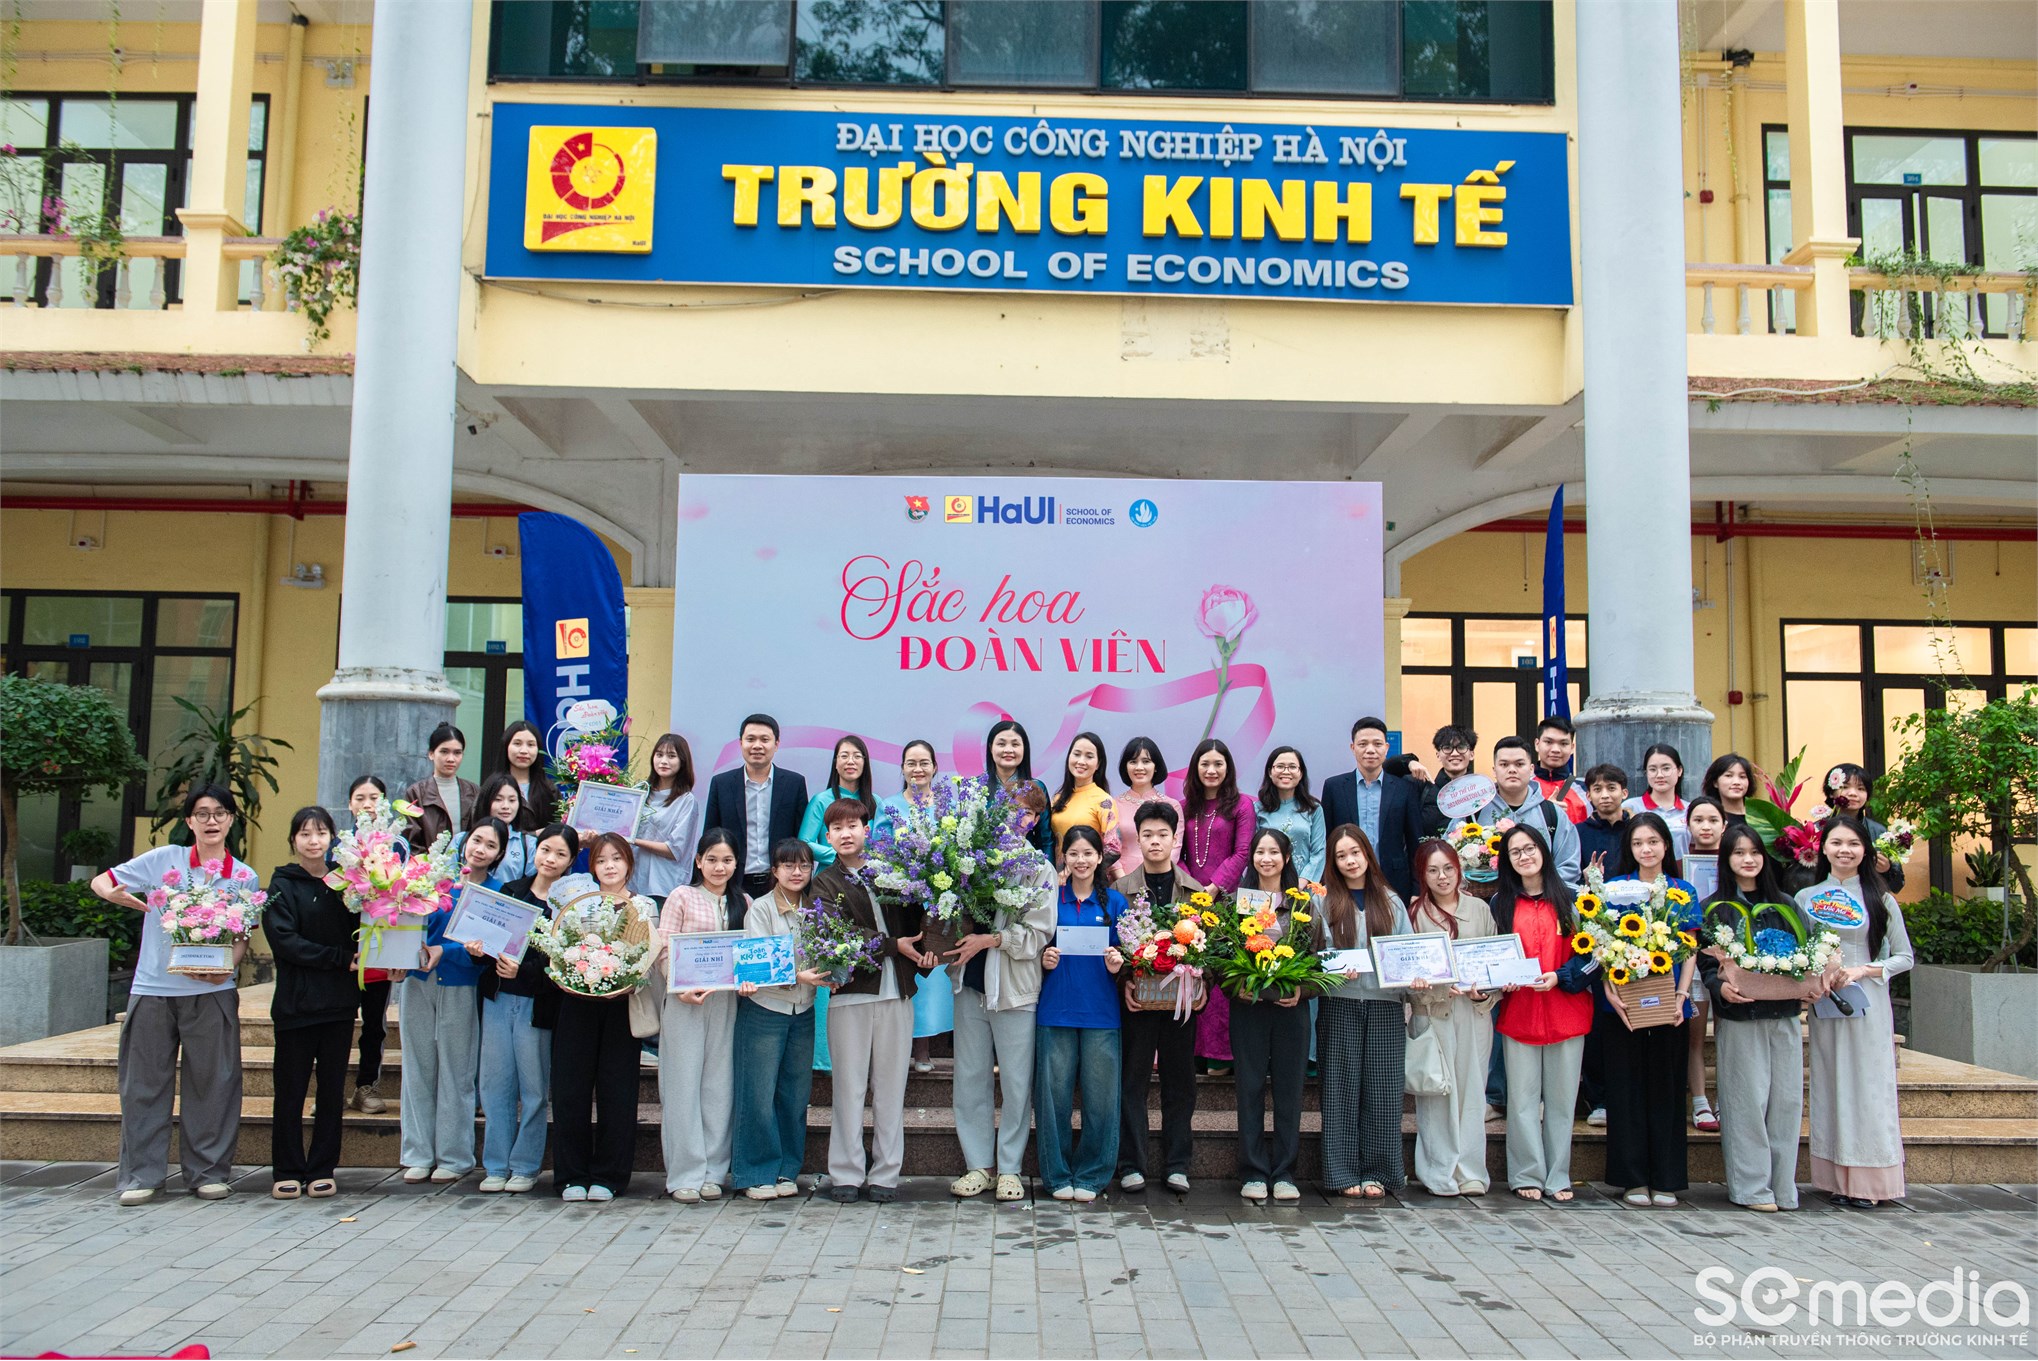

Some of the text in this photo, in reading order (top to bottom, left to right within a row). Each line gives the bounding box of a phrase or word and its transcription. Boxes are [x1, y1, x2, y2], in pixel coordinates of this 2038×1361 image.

[836, 119, 1407, 173] ĐẠI HỌC CÔNG NGHIỆP HÀ NỘI
[721, 152, 1516, 248] TRƯỜNG KINH TẾ
[833, 246, 1410, 290] SCHOOL OF ECONOMICS
[978, 496, 1055, 525] HaUI
[1066, 508, 1112, 516] SCHOOL OF
[1066, 518, 1115, 526] ECONOMICS
[979, 574, 1085, 624] hoa
[896, 627, 1166, 674] ĐOÀN VIÊN
